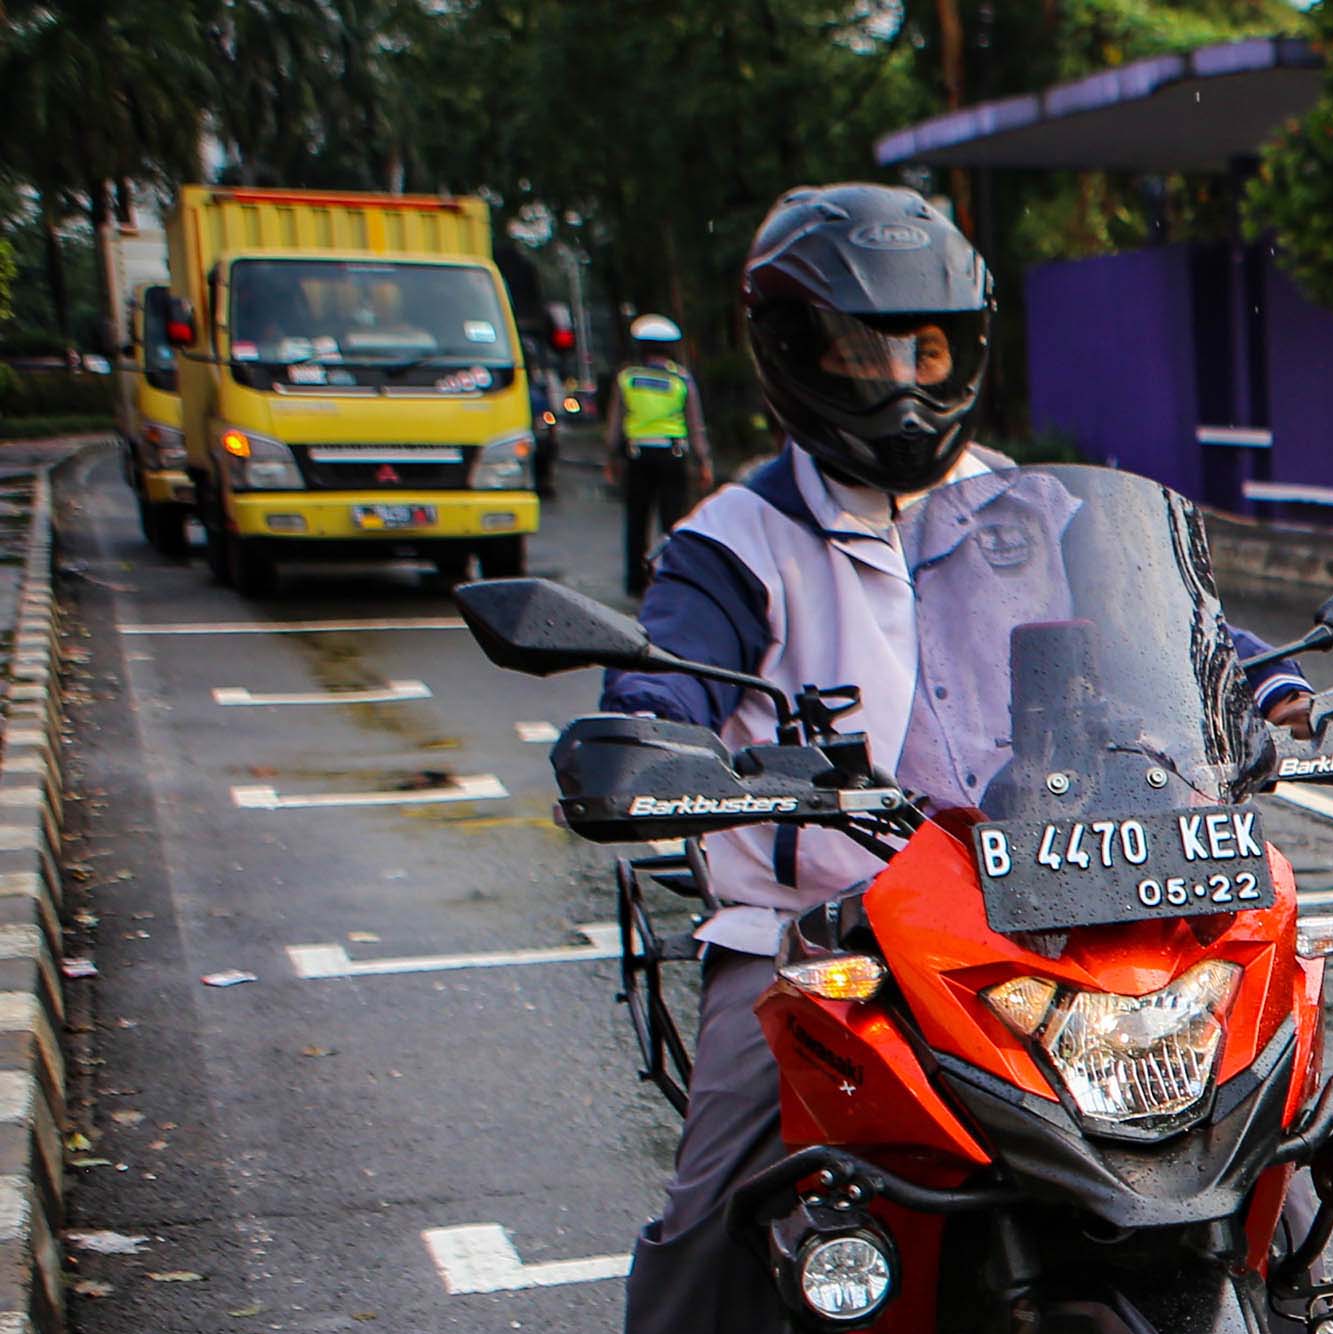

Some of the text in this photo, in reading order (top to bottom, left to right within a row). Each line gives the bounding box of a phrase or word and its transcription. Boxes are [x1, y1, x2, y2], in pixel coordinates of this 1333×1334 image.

[859, 224, 925, 243] Arai
[629, 794, 800, 817] Barkbusters
[980, 811, 1263, 878] B 4470 KEK
